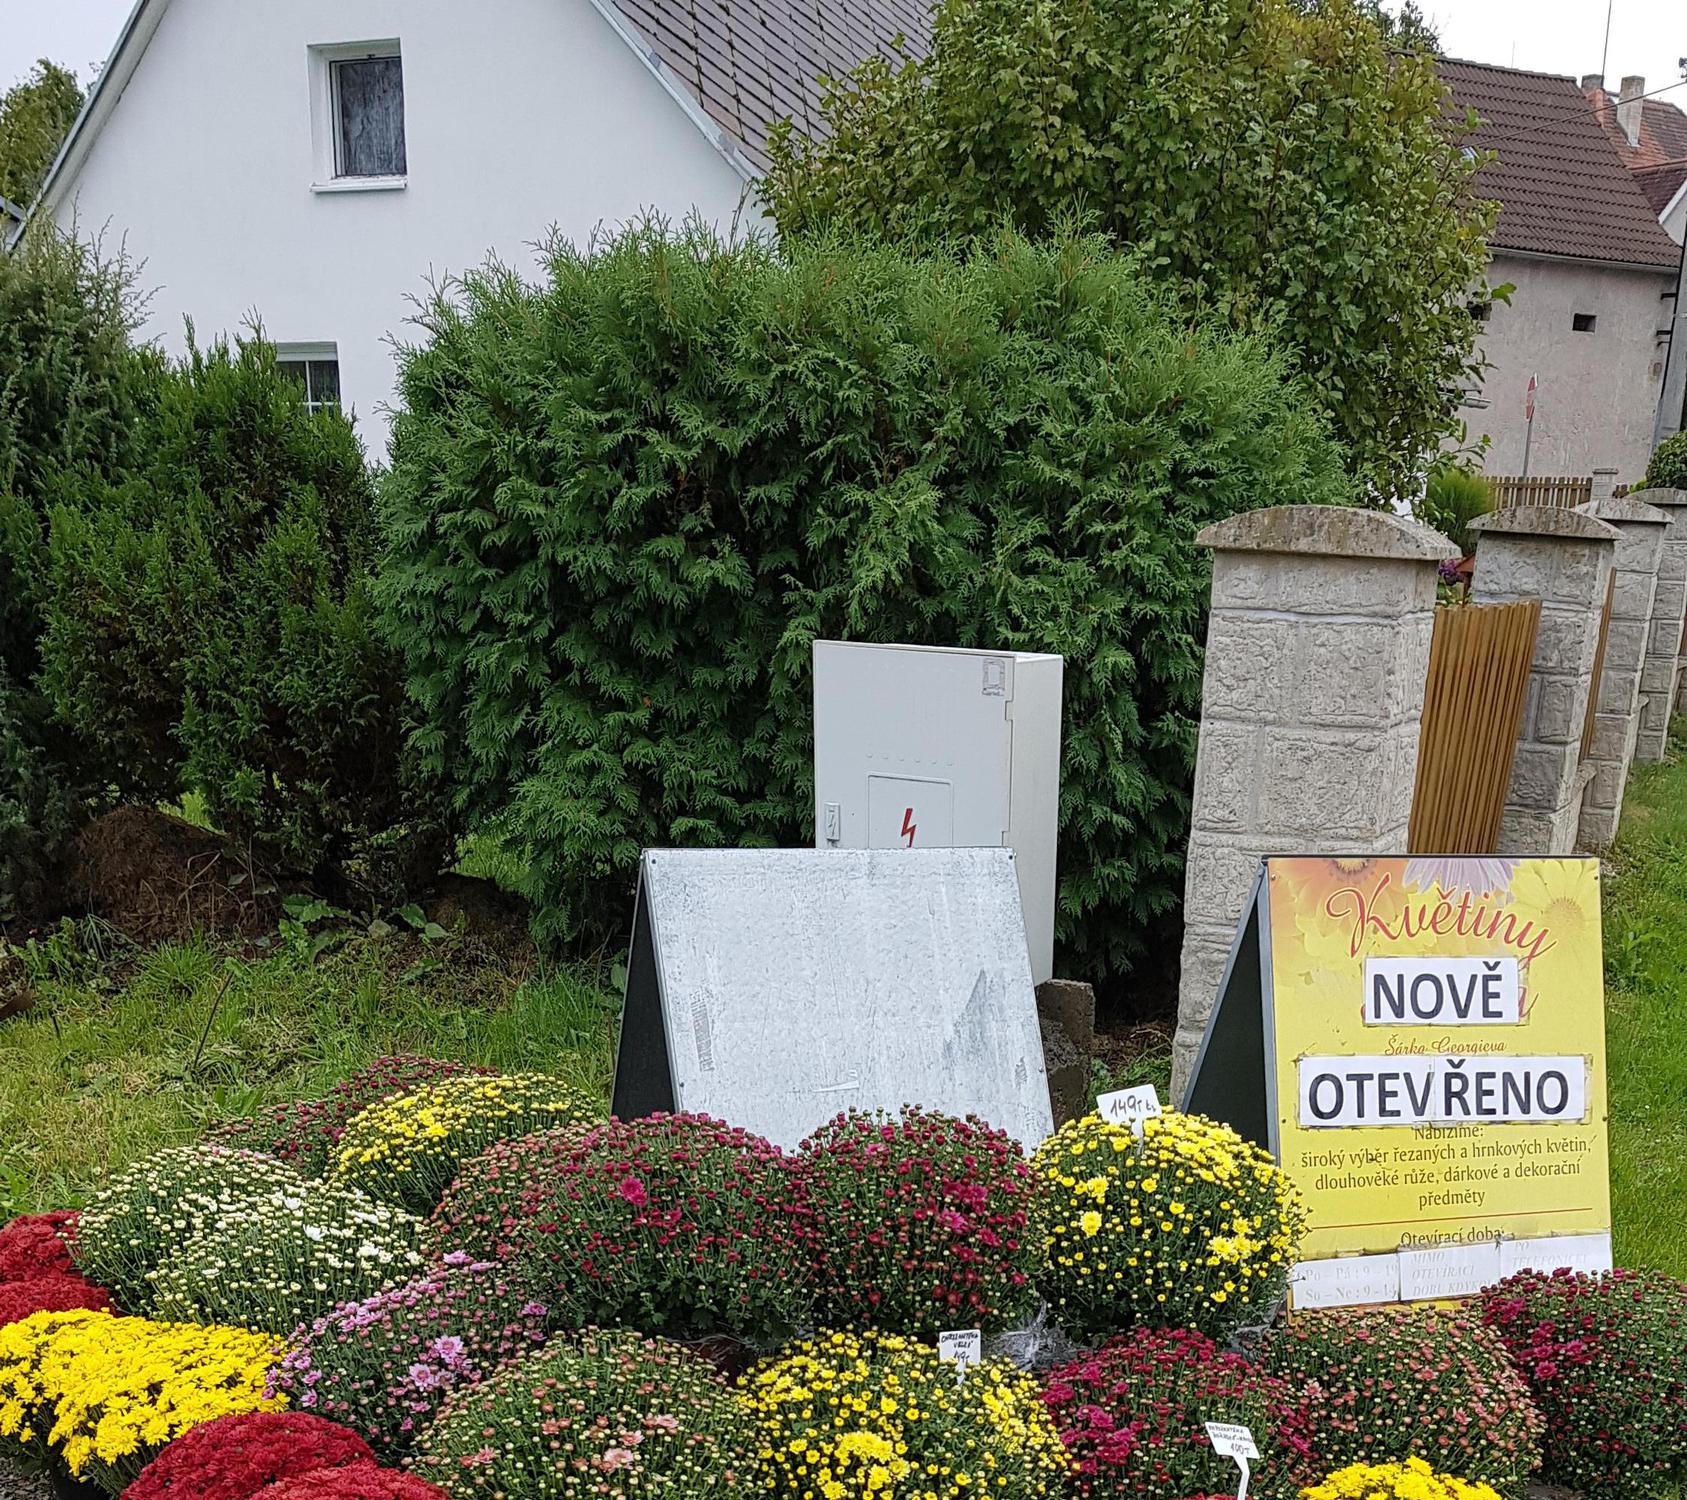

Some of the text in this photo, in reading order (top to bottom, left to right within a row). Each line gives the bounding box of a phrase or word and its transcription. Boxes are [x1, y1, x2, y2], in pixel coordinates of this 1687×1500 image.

[1325, 873, 1557, 971] Květiny
[1373, 961, 1503, 1019] NOVĚ
[1385, 1034, 1506, 1056] Šárka Georgieva
[1308, 1059, 1569, 1120] OTEVŘENO
[1301, 1136, 1591, 1170] široký výběr řezaných a hrnkových květin,
[1315, 1158, 1580, 1190] dlouhověké růže, dárkové a dekorační
[1418, 1189, 1486, 1211] předměty
[1401, 1227, 1463, 1247] Otevírací
